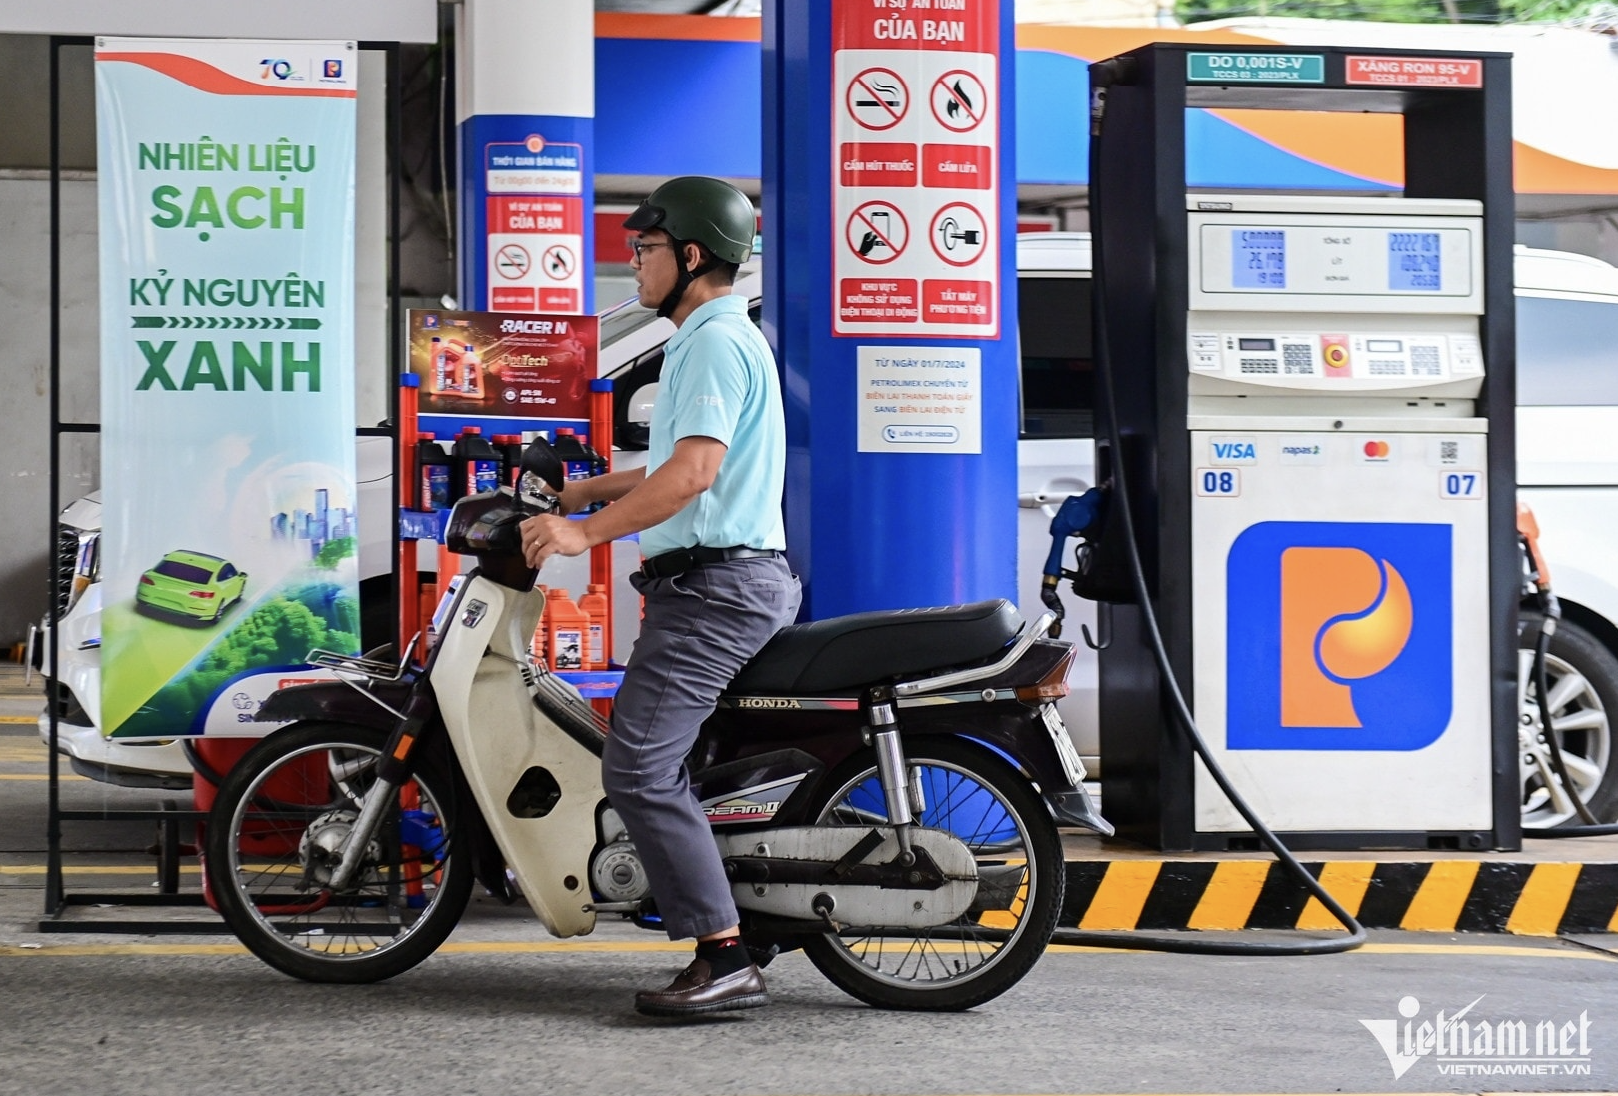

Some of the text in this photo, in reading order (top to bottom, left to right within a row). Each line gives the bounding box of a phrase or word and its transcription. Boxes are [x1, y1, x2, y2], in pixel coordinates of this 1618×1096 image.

[873, 12, 965, 45] CỦA BẠN
[1208, 56, 1303, 70] DO 0,001S-V
[1357, 59, 1471, 75] XĂNG RON 95-V
[138, 135, 315, 181] NHIÊN LIỆU
[151, 185, 304, 242] SẠCH
[130, 269, 325, 308] KỶ NGUYÊN
[500, 320, 568, 335] RACER N
[135, 340, 321, 392] XANH
[891, 357, 918, 368] NGÀY
[1212, 443, 1256, 459] VISA
[1203, 471, 1233, 493] 08
[1446, 474, 1476, 495] 07
[738, 698, 802, 708] HONDA
[702, 805, 763, 816] REAM
